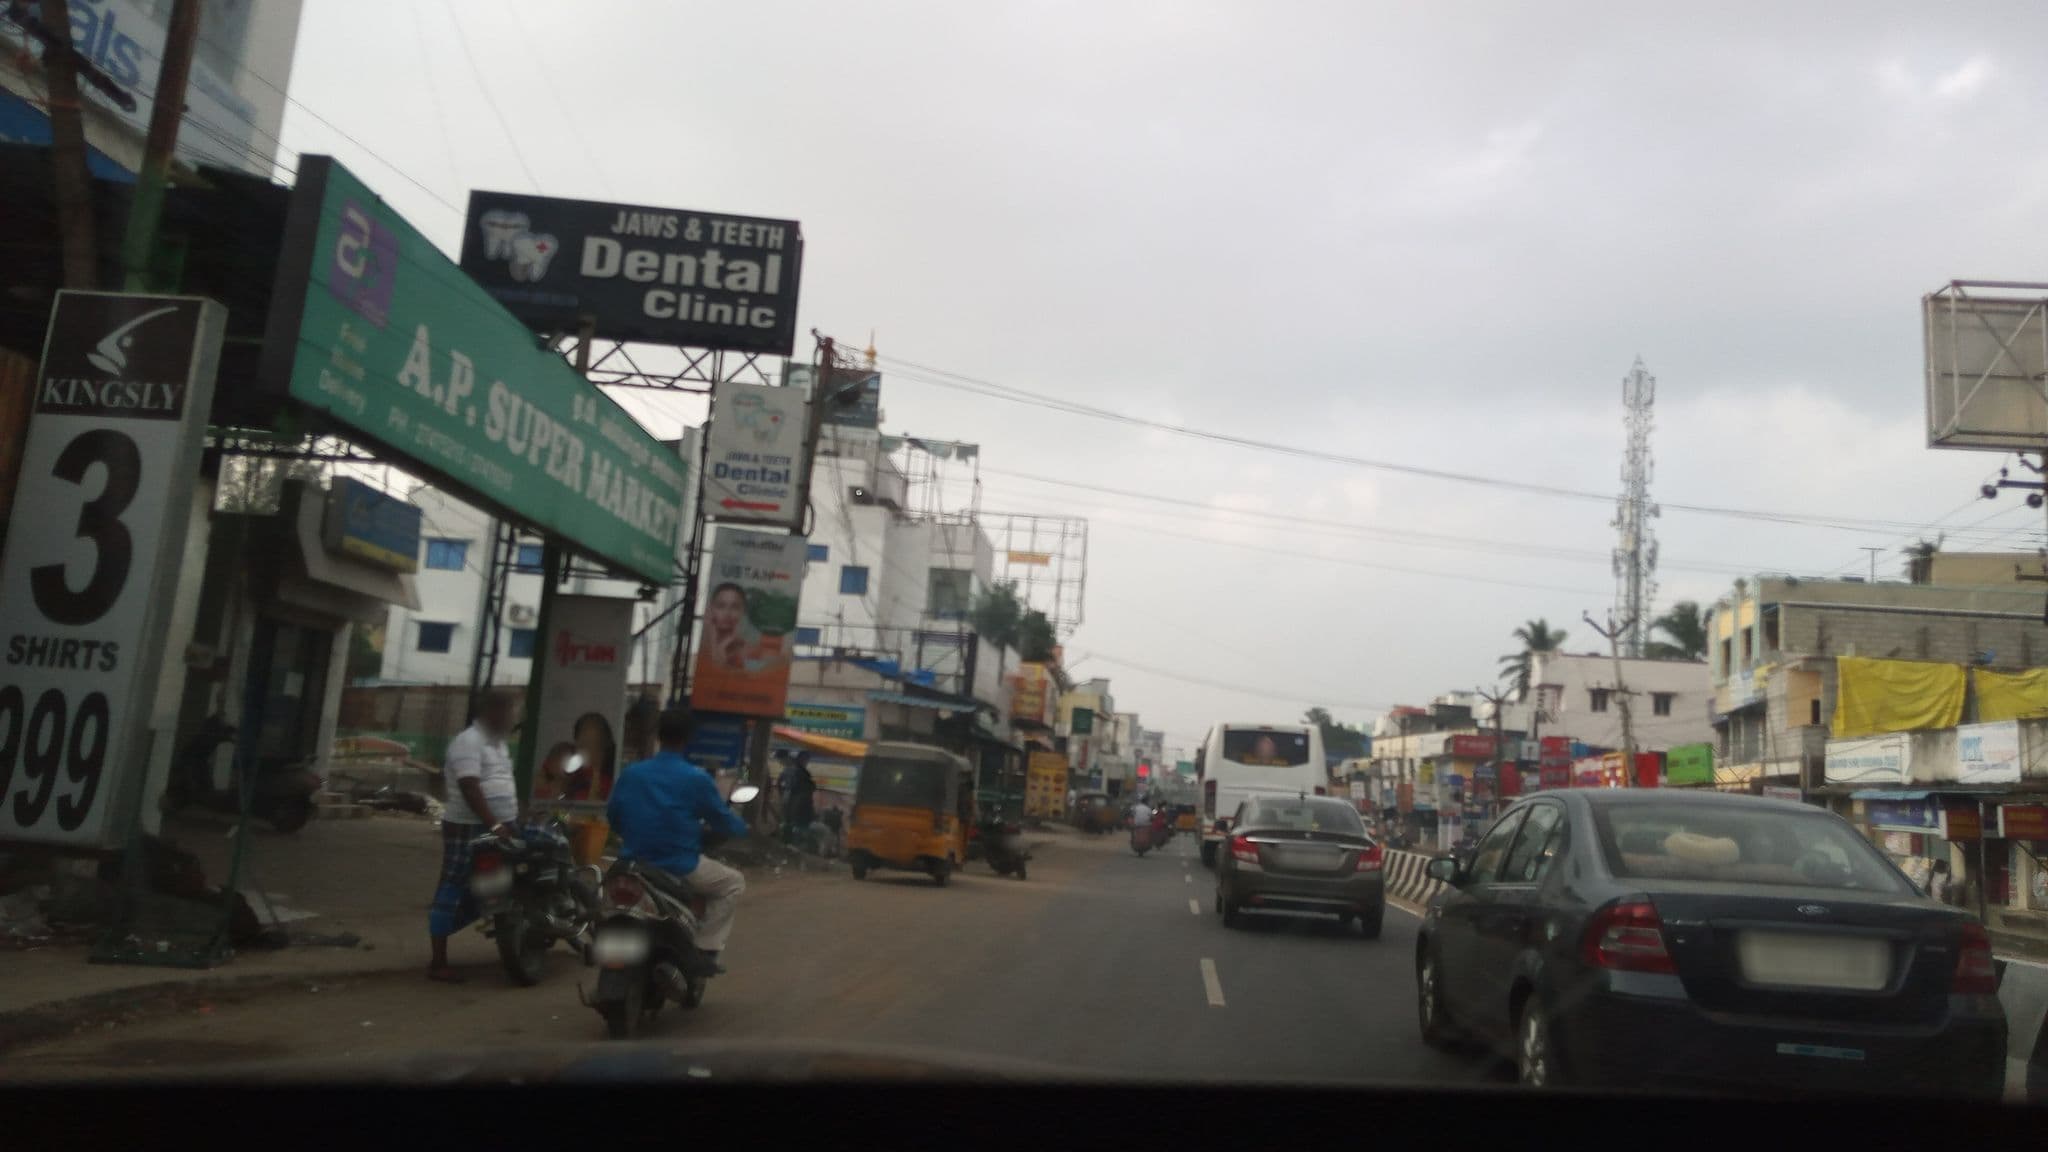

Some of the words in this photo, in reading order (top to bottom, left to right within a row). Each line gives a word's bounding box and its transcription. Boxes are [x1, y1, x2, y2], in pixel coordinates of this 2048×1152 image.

[611, 211, 679, 239] JAWS
[684, 215, 702, 241] &
[710, 219, 785, 249] TEETH
[580, 236, 783, 295] Dental
[643, 290, 777, 328] Clinic
[43, 378, 184, 410] KINGSLY
[397, 323, 477, 427] A.P.
[484, 380, 585, 494] SUPER
[584, 450, 681, 547] MARKET
[714, 462, 791, 484] Dental
[736, 482, 787, 497] Clinic
[31, 428, 142, 626] 3
[6, 634, 120, 672] SHIRTS
